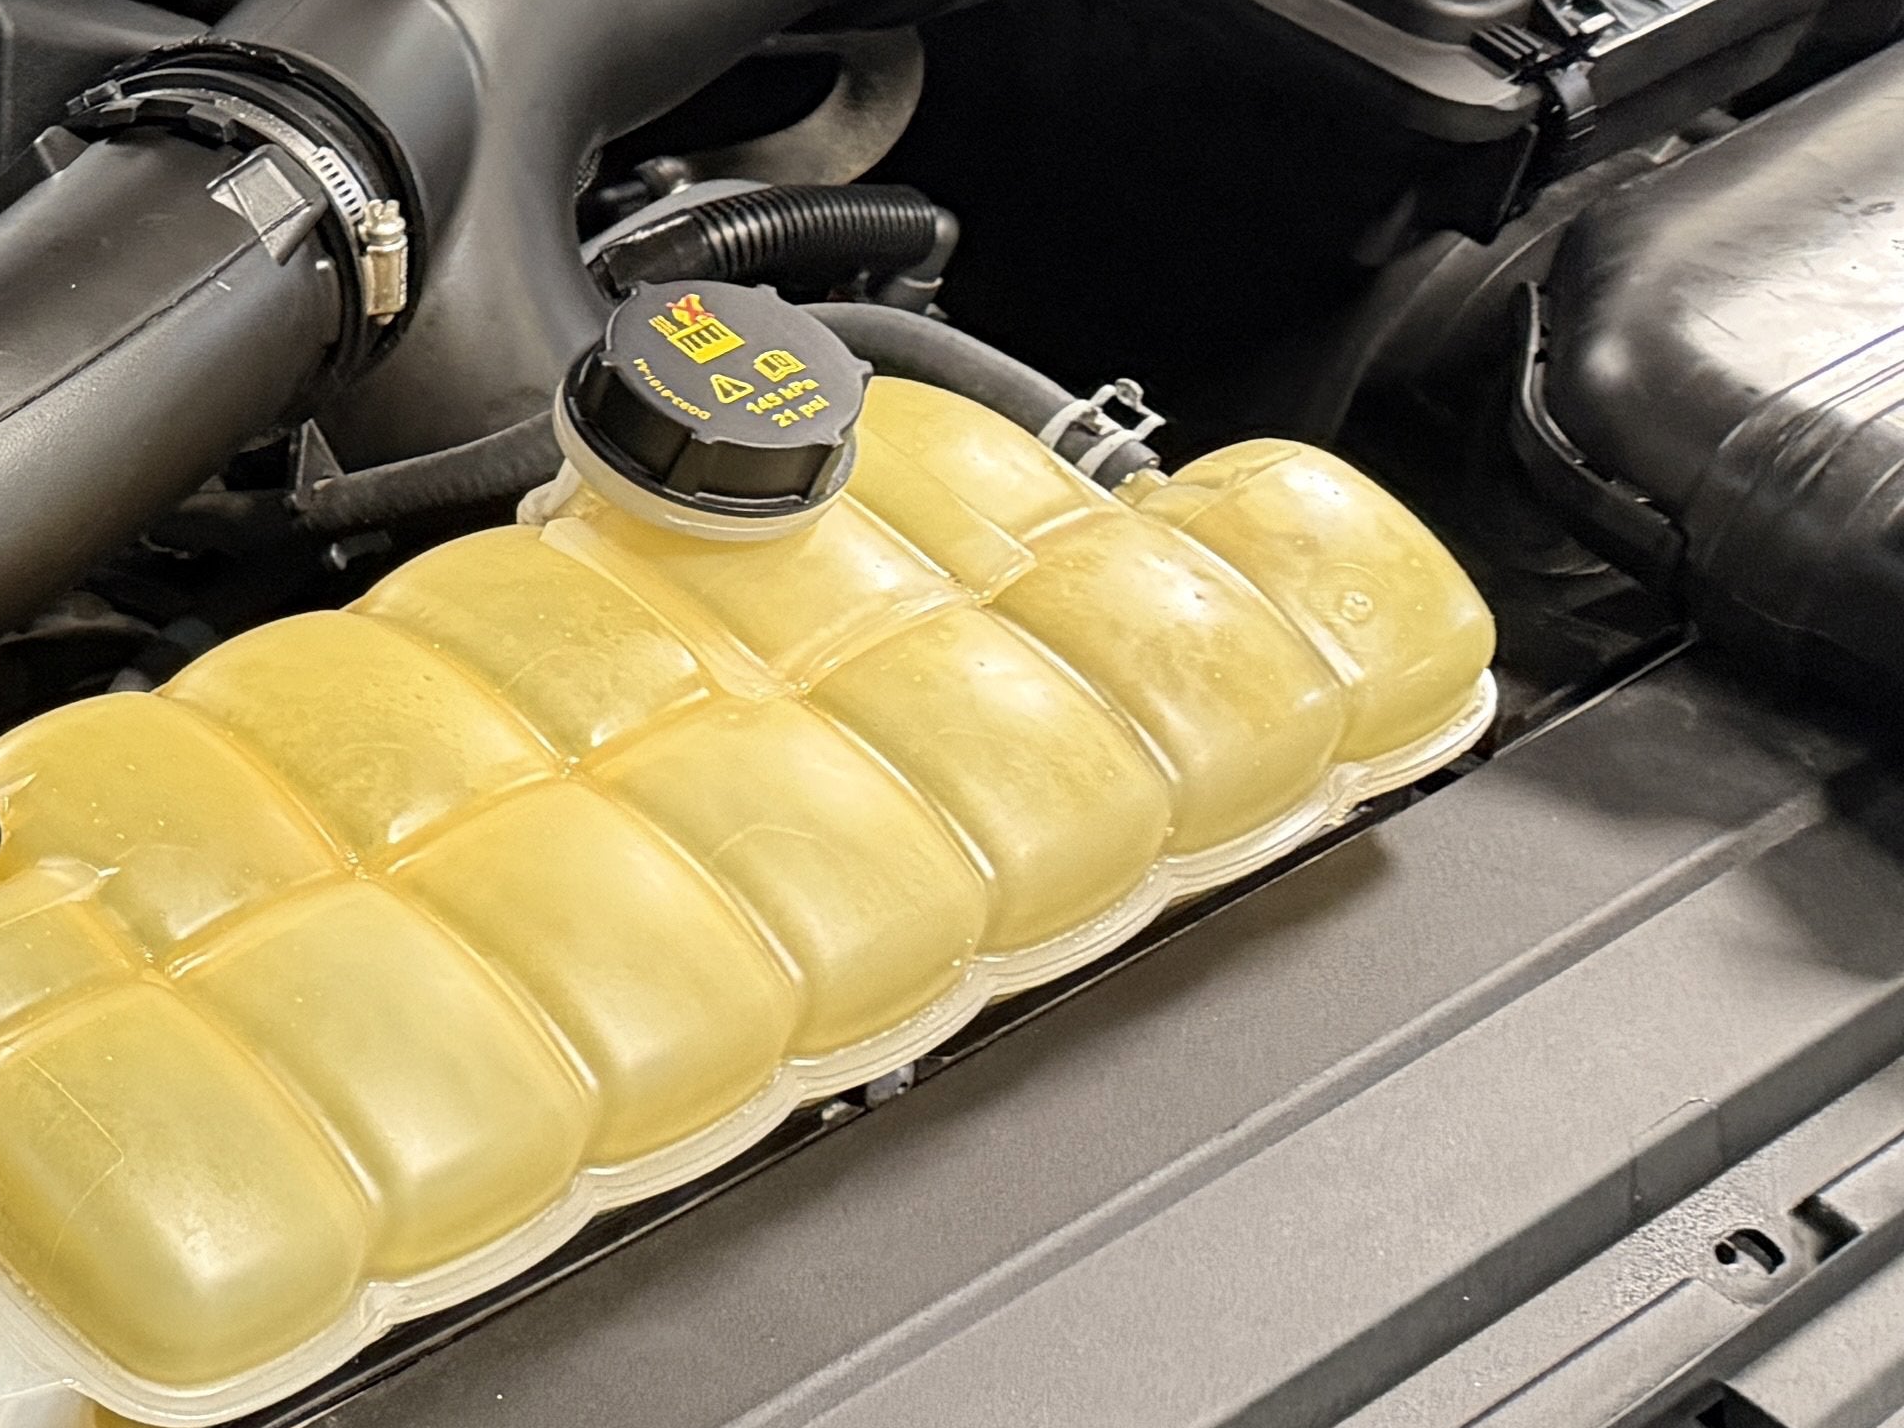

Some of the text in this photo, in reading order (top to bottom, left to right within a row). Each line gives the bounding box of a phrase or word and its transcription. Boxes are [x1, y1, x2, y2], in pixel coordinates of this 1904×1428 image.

[745, 377, 821, 415] 145 kPa
[770, 394, 831, 428] 21 psi
